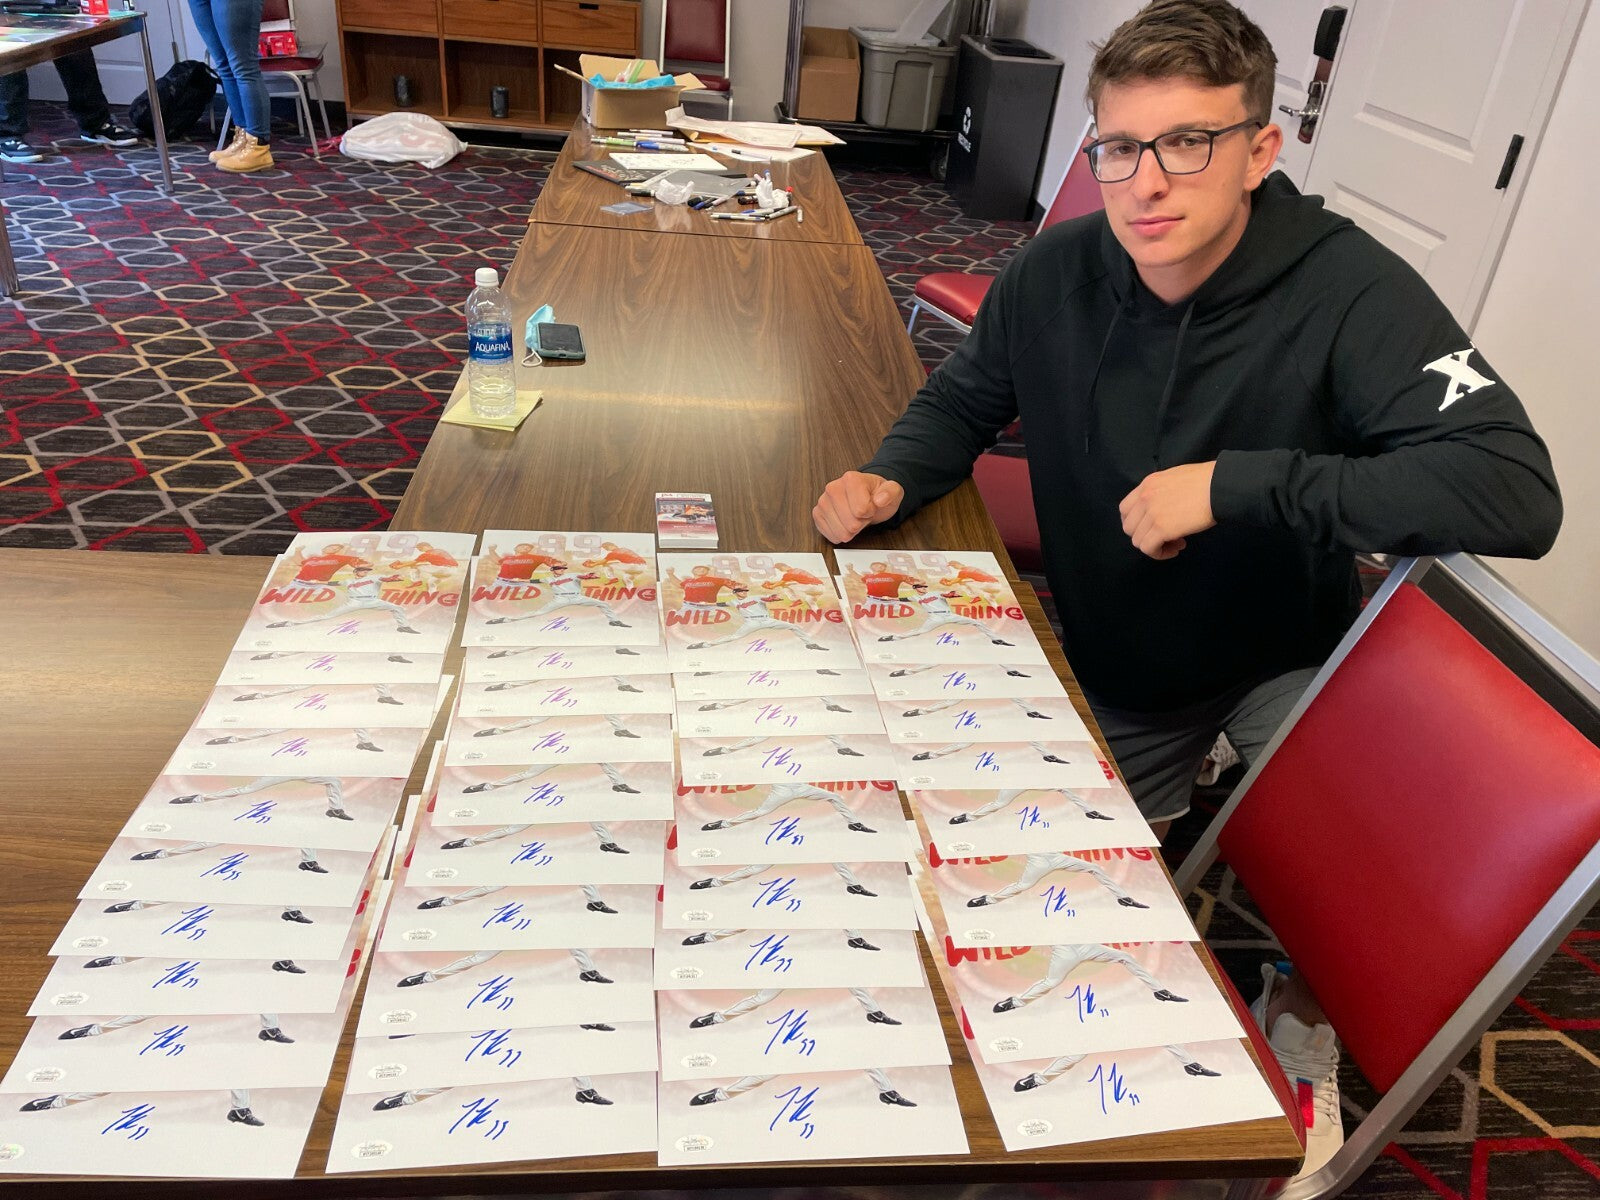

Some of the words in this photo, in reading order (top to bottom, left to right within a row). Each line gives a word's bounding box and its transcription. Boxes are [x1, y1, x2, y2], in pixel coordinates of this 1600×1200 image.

[475, 341, 511, 353] AQUAFINA
[259, 588, 336, 604] WILD
[379, 588, 460, 607] THING
[471, 586, 541, 602] WILD
[583, 586, 656, 602] THING
[666, 609, 731, 627] WILD
[770, 608, 844, 623] THING
[854, 604, 915, 619] WILD
[951, 604, 1024, 621] THING
